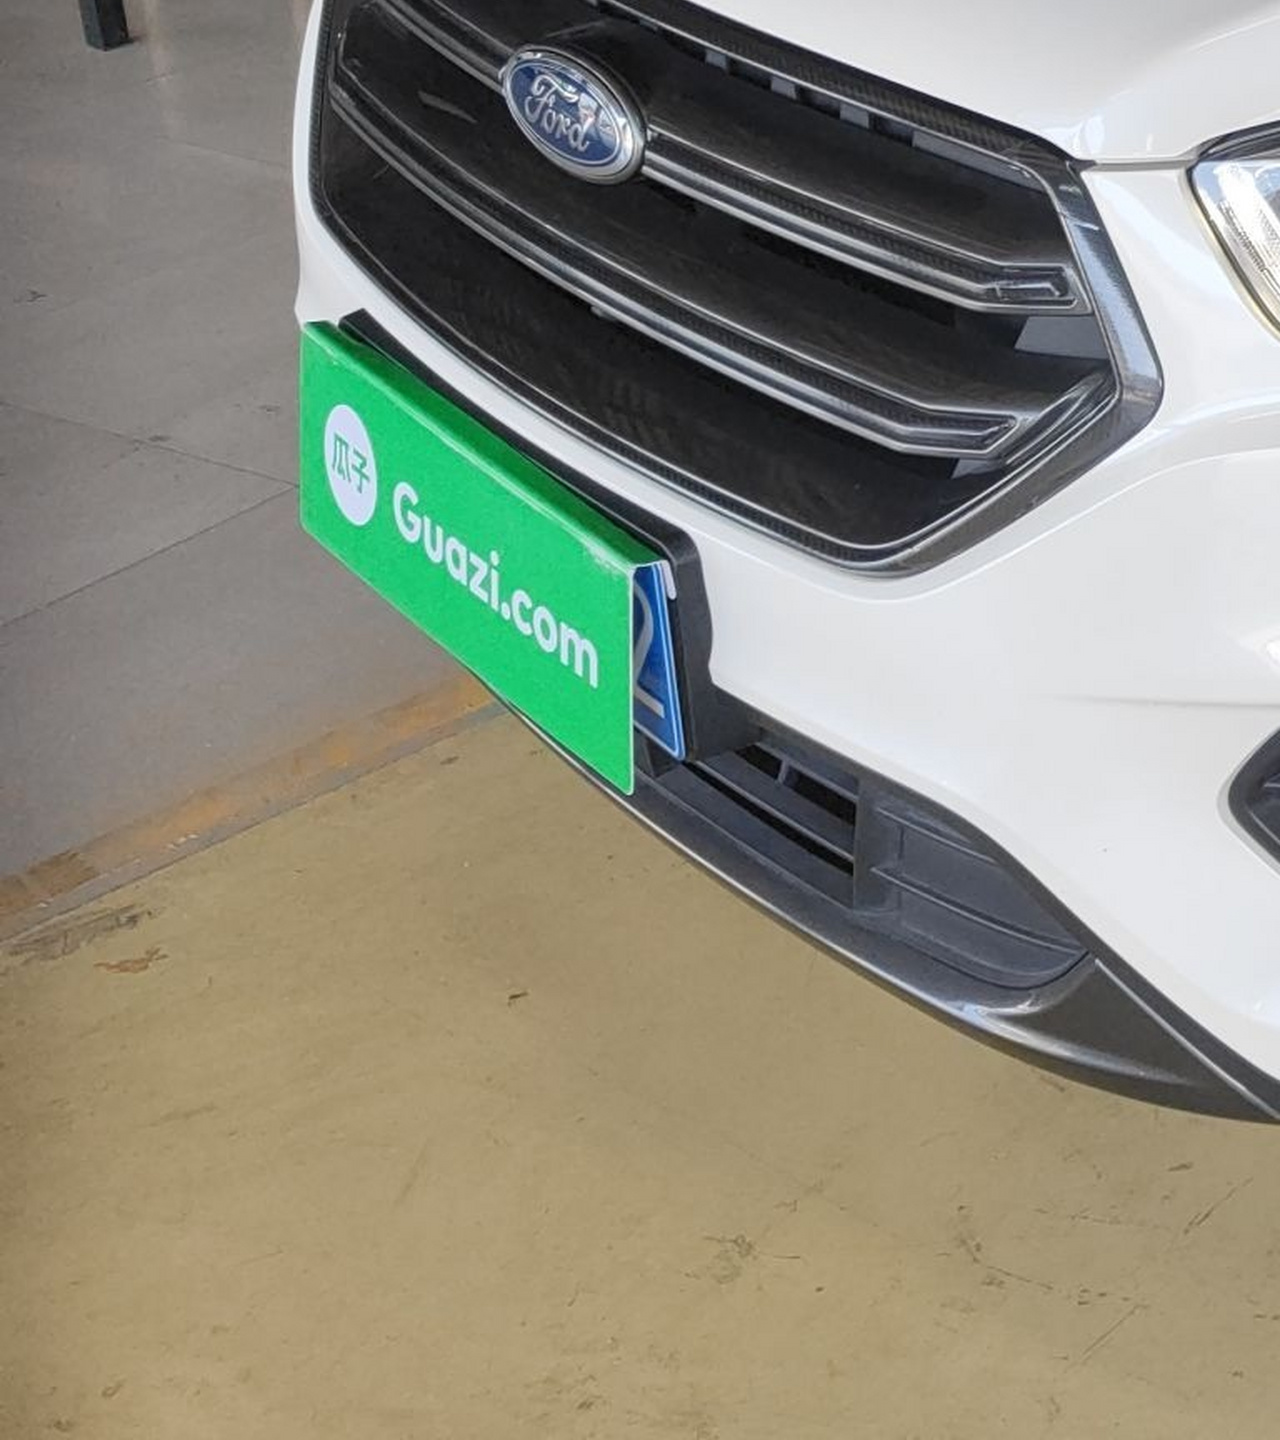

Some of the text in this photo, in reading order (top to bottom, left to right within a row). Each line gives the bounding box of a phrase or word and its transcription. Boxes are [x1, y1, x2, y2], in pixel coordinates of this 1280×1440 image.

[524, 74, 593, 152] Ford
[331, 433, 371, 494] 瓜子
[393, 481, 599, 689] Guazi.com
